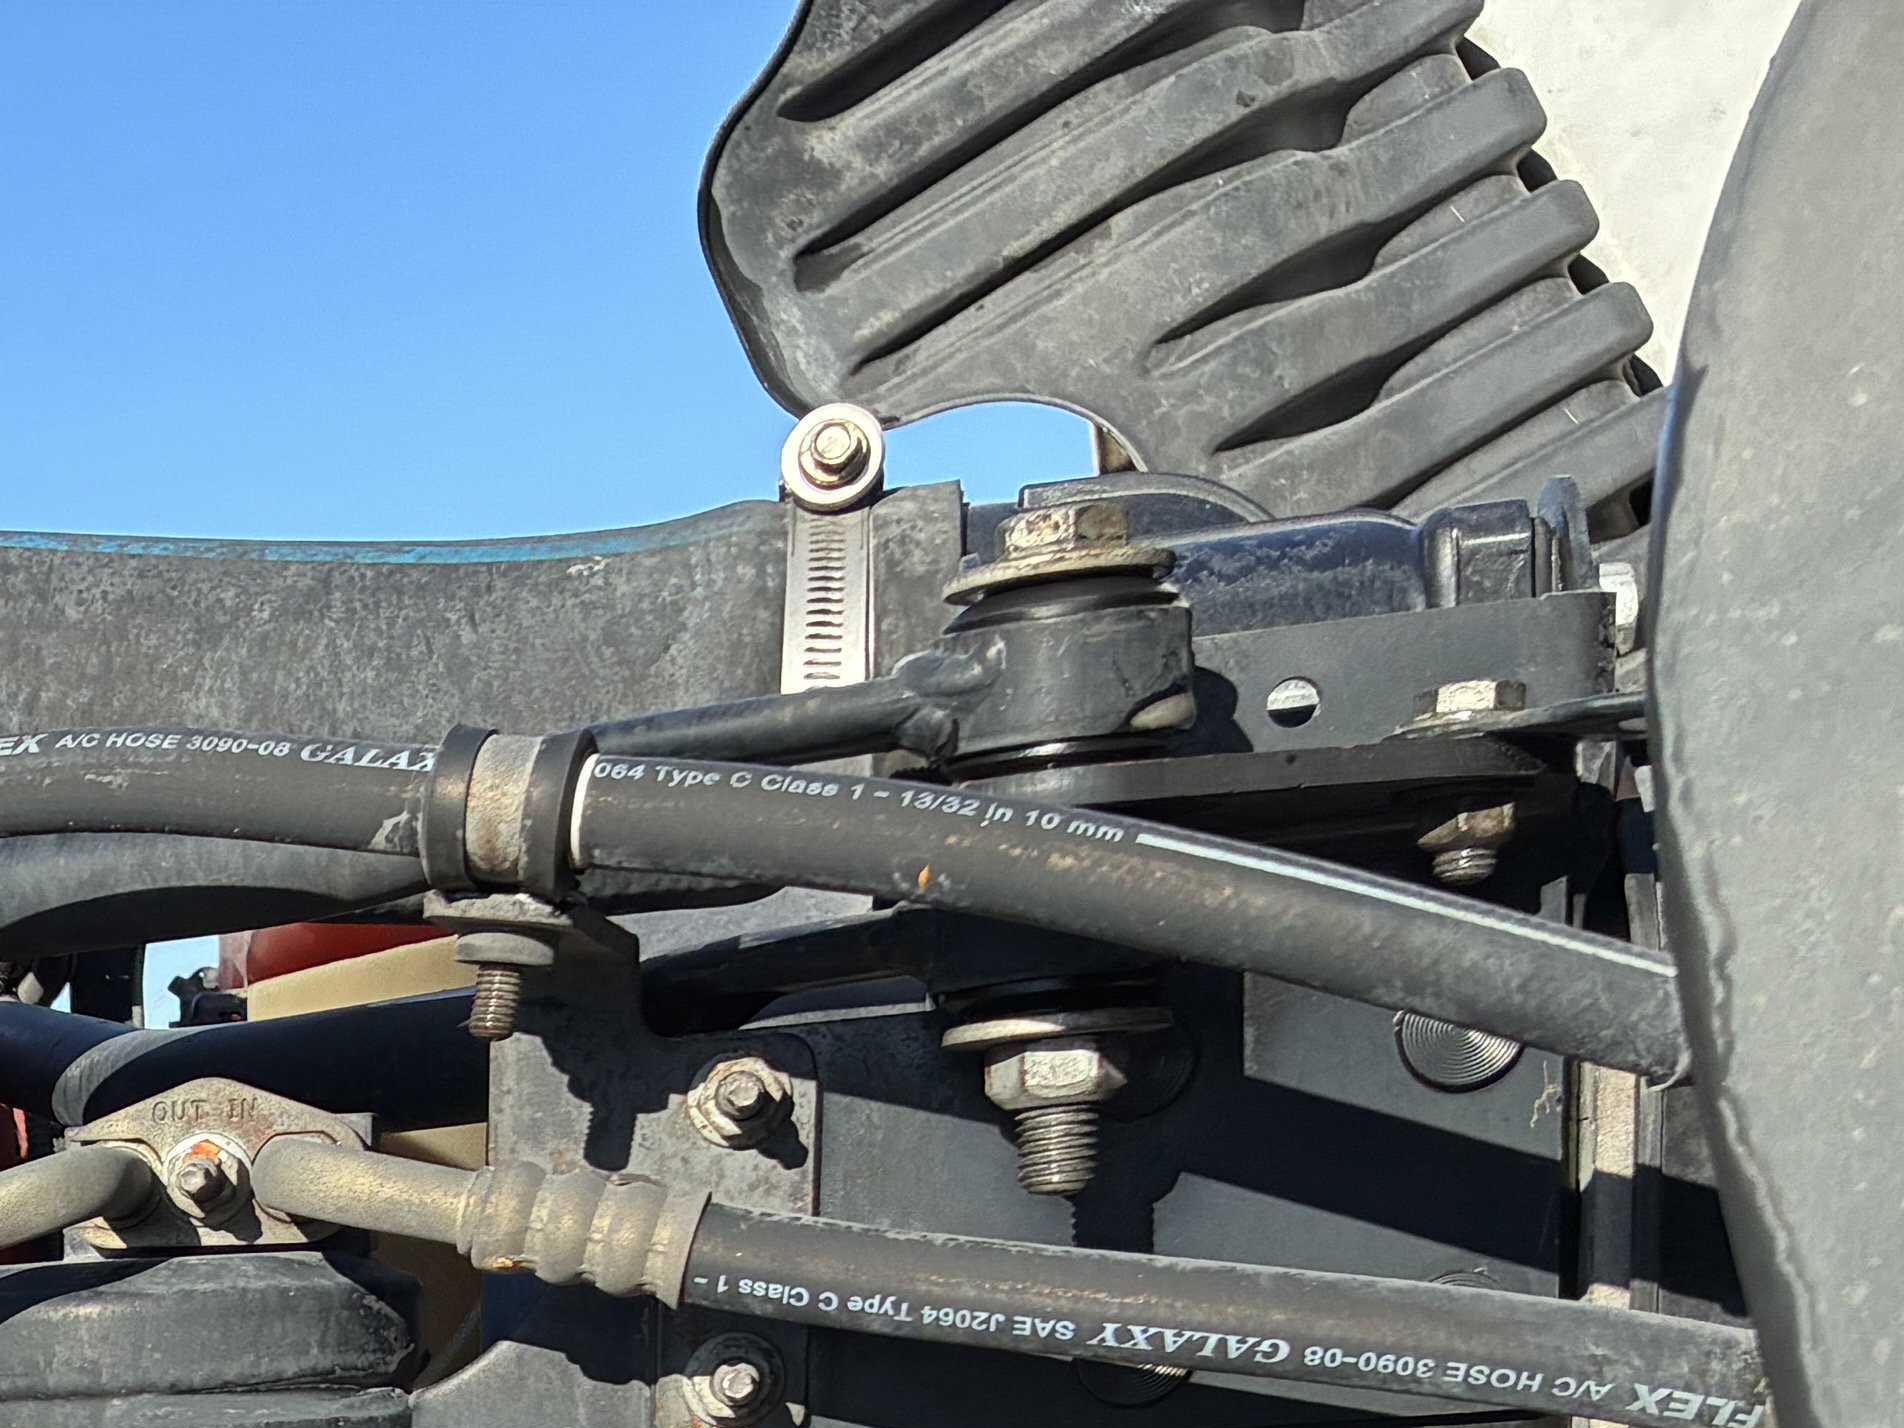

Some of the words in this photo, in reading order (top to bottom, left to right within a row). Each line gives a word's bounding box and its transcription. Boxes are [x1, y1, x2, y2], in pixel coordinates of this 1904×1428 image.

[55, 732, 99, 750] A/C
[105, 732, 182, 750] HOSE
[186, 735, 291, 758] 3090-08
[300, 743, 438, 772] GALAX
[593, 761, 645, 781] 064
[655, 765, 722, 787] Type
[731, 771, 753, 788] C
[761, 774, 839, 798] Class
[851, 782, 863, 800] 1
[900, 788, 978, 818] 13/32
[1026, 809, 1063, 831] 10
[1067, 820, 1125, 845] mm
[151, 1098, 208, 1123] OUT
[227, 1096, 258, 1120] IN
[717, 1274, 729, 1294] 1
[737, 1279, 809, 1308] Class
[818, 1291, 839, 1312] C
[847, 1293, 913, 1322] Type
[921, 1304, 1005, 1333] J2064
[1012, 1315, 1076, 1339] SAE
[1086, 1322, 1291, 1365] GALAXY
[1303, 1346, 1437, 1379] 3090-08
[1444, 1361, 1544, 1394] HOSE
[1553, 1376, 1613, 1402] A/C
